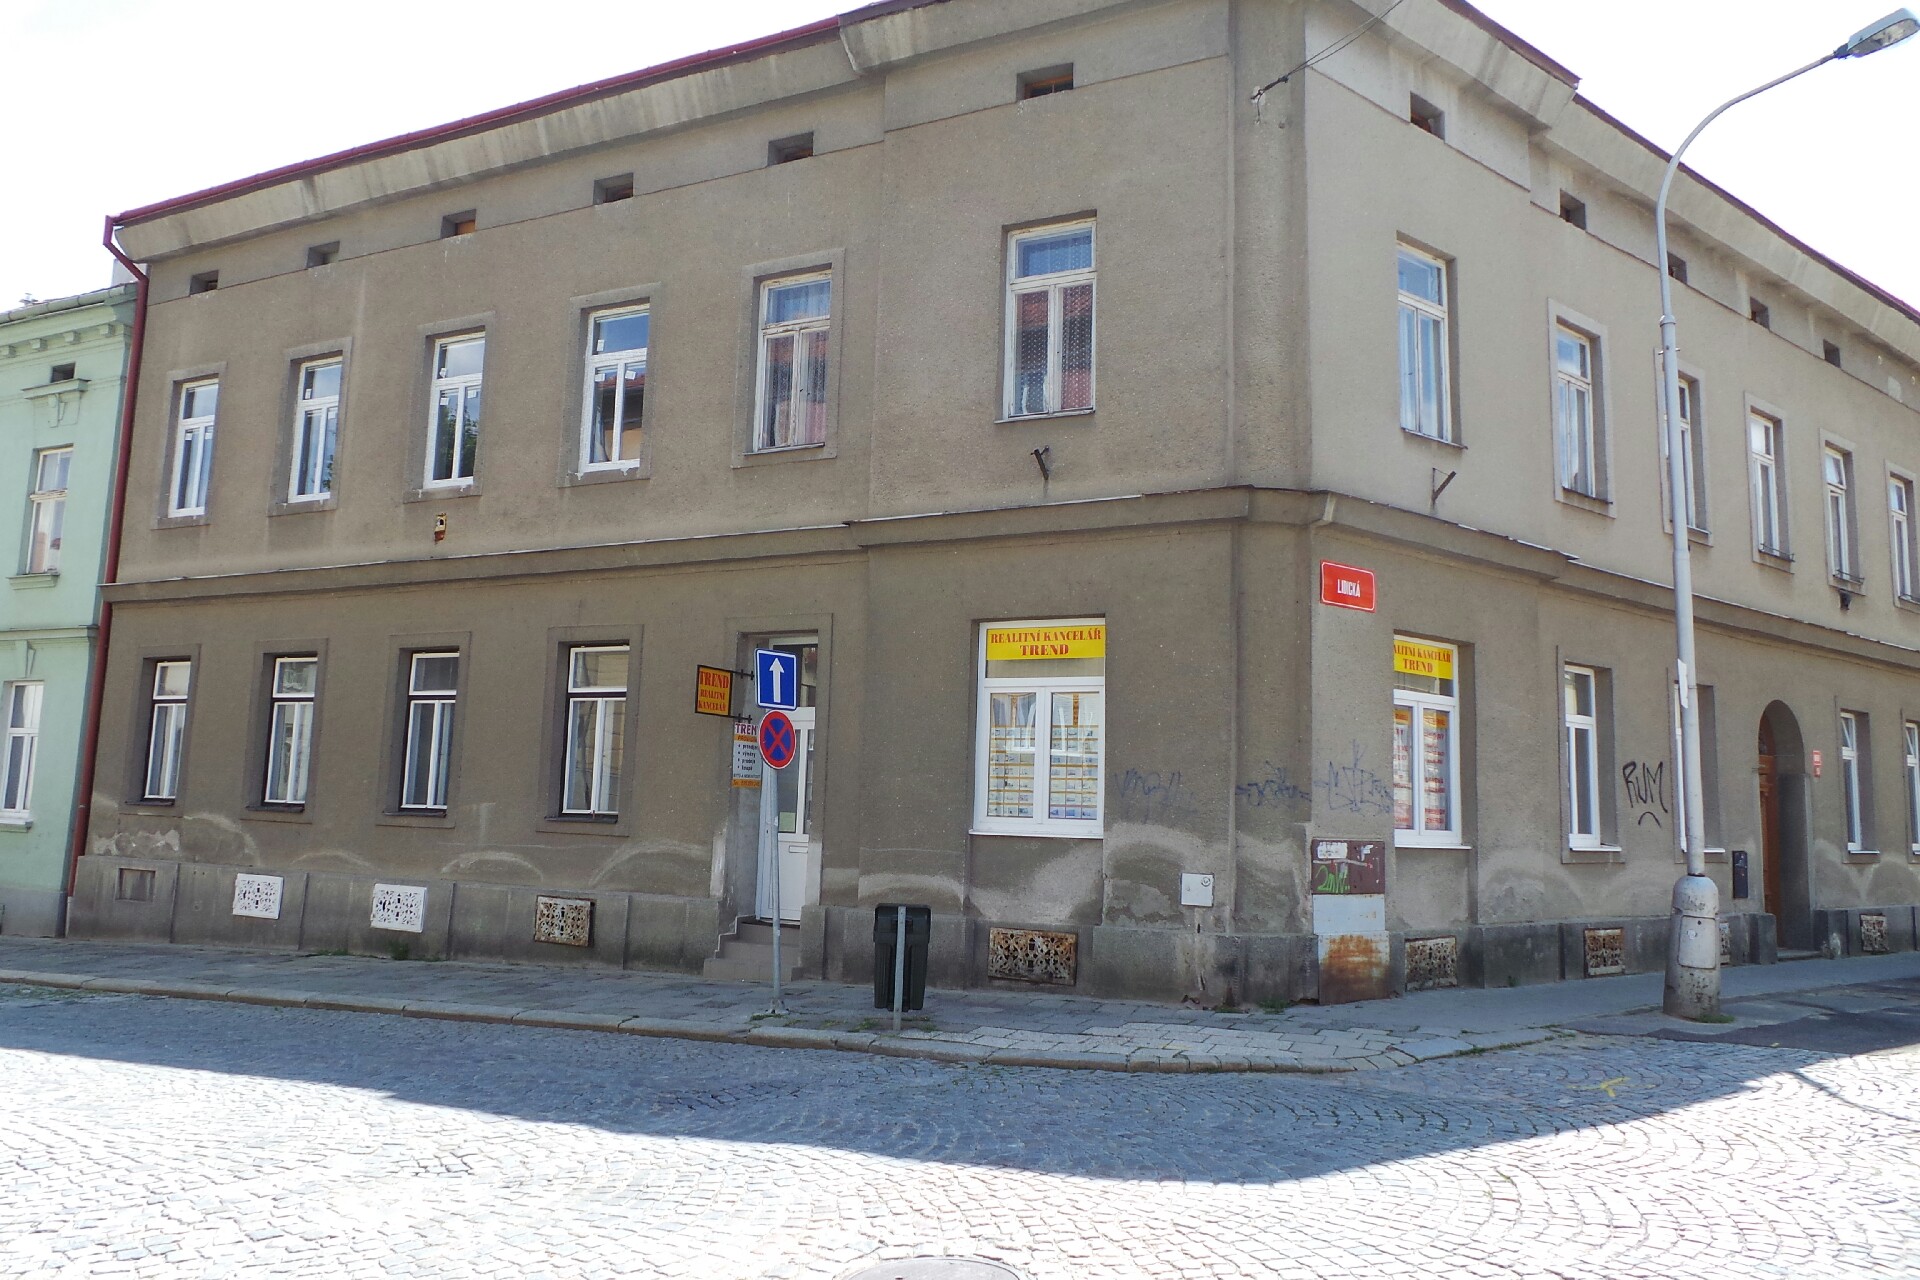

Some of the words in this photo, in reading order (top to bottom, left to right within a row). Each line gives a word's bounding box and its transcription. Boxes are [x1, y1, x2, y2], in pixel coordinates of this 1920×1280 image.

[1337, 579, 1361, 598] LIDICKÁ
[990, 630, 1041, 643] REALITNÍ
[1043, 628, 1101, 642] KANCELÁŘ
[1020, 644, 1069, 656] TREND
[1417, 648, 1451, 663] KANCELÁŘ
[1403, 658, 1433, 673] TREND
[700, 671, 729, 689] TREND
[735, 723, 758, 736] TREN
